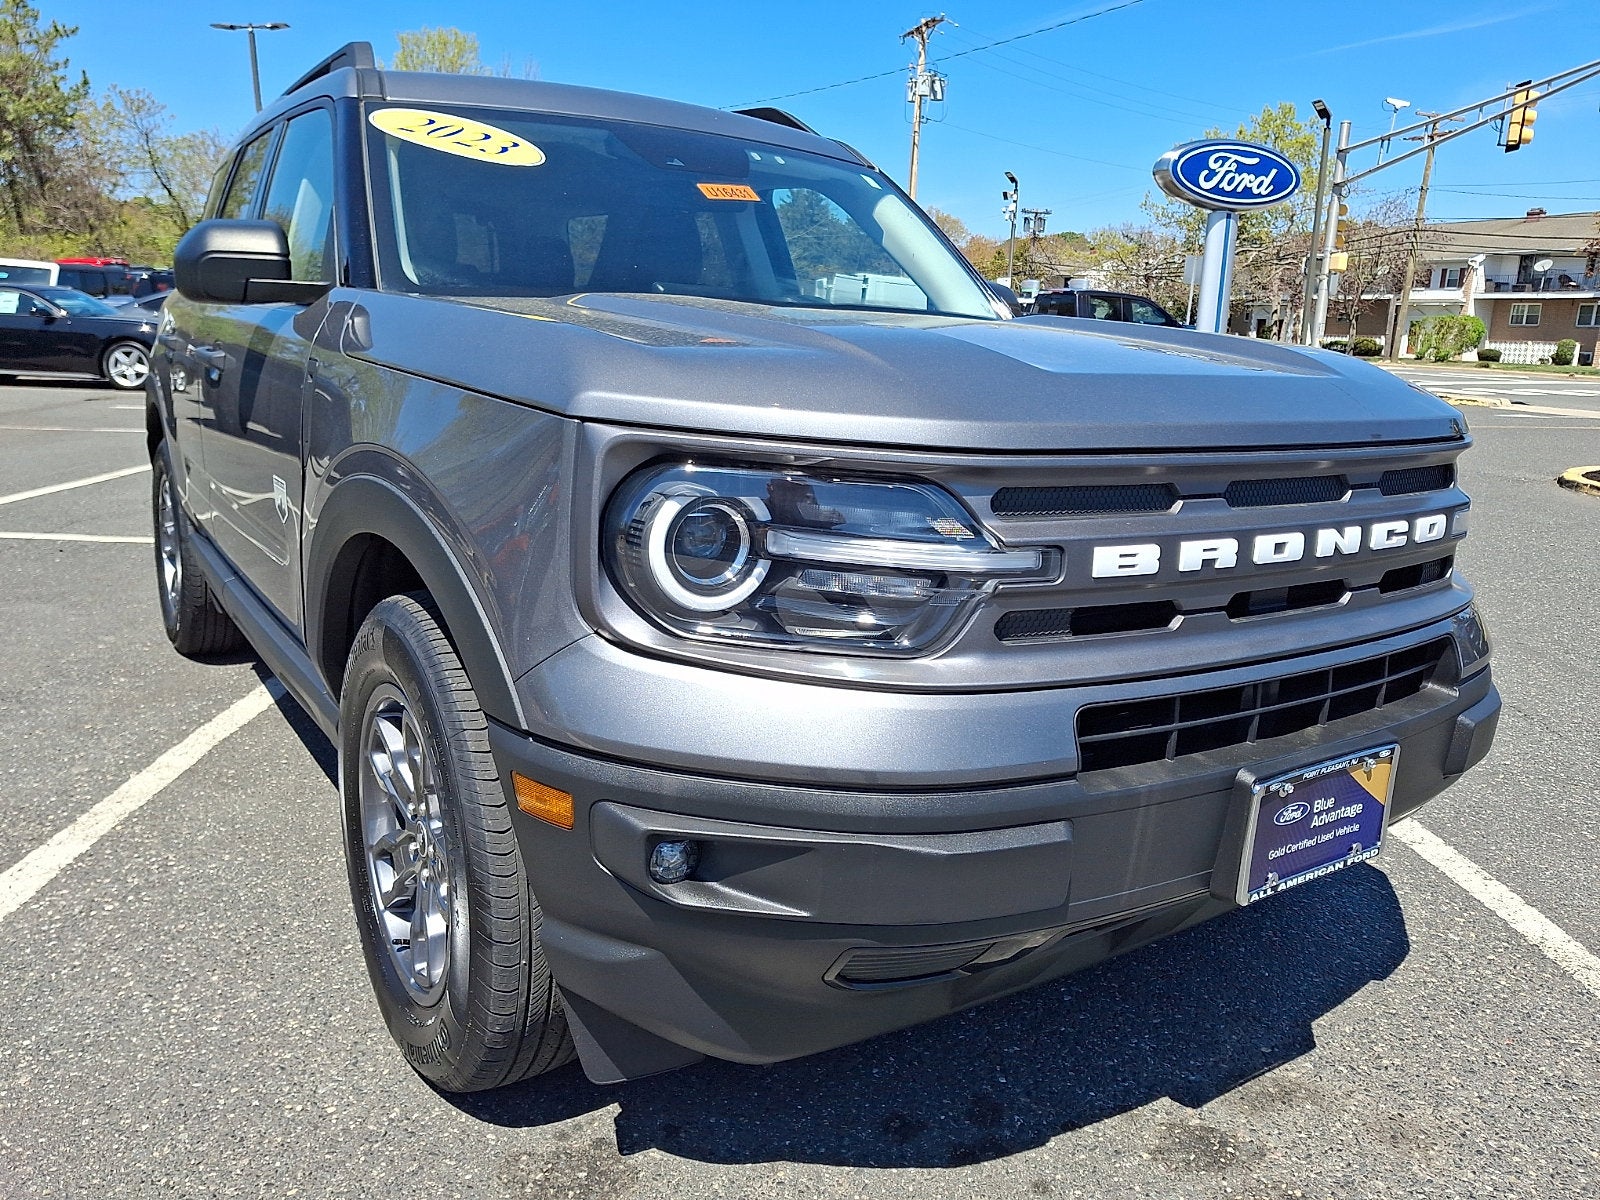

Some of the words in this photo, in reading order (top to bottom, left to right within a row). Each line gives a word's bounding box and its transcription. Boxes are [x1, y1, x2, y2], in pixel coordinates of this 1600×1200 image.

[397, 117, 520, 155] 2023
[1198, 152, 1279, 196] Ford
[705, 186, 753, 199] U16431
[1091, 513, 1447, 578] BRONCO
[1302, 768, 1320, 780] POINT
[1279, 806, 1303, 823] Ford
[1310, 803, 1364, 828] Advantage
[1313, 797, 1335, 813] Blue
[1268, 847, 1285, 860] Gold
[1285, 838, 1317, 854] Certified
[1317, 830, 1335, 844] Used
[1335, 823, 1360, 838] Vehicle
[1249, 889, 1276, 903] ALL
[1277, 862, 1344, 892] AMERICAN
[1347, 848, 1379, 866] FORD
